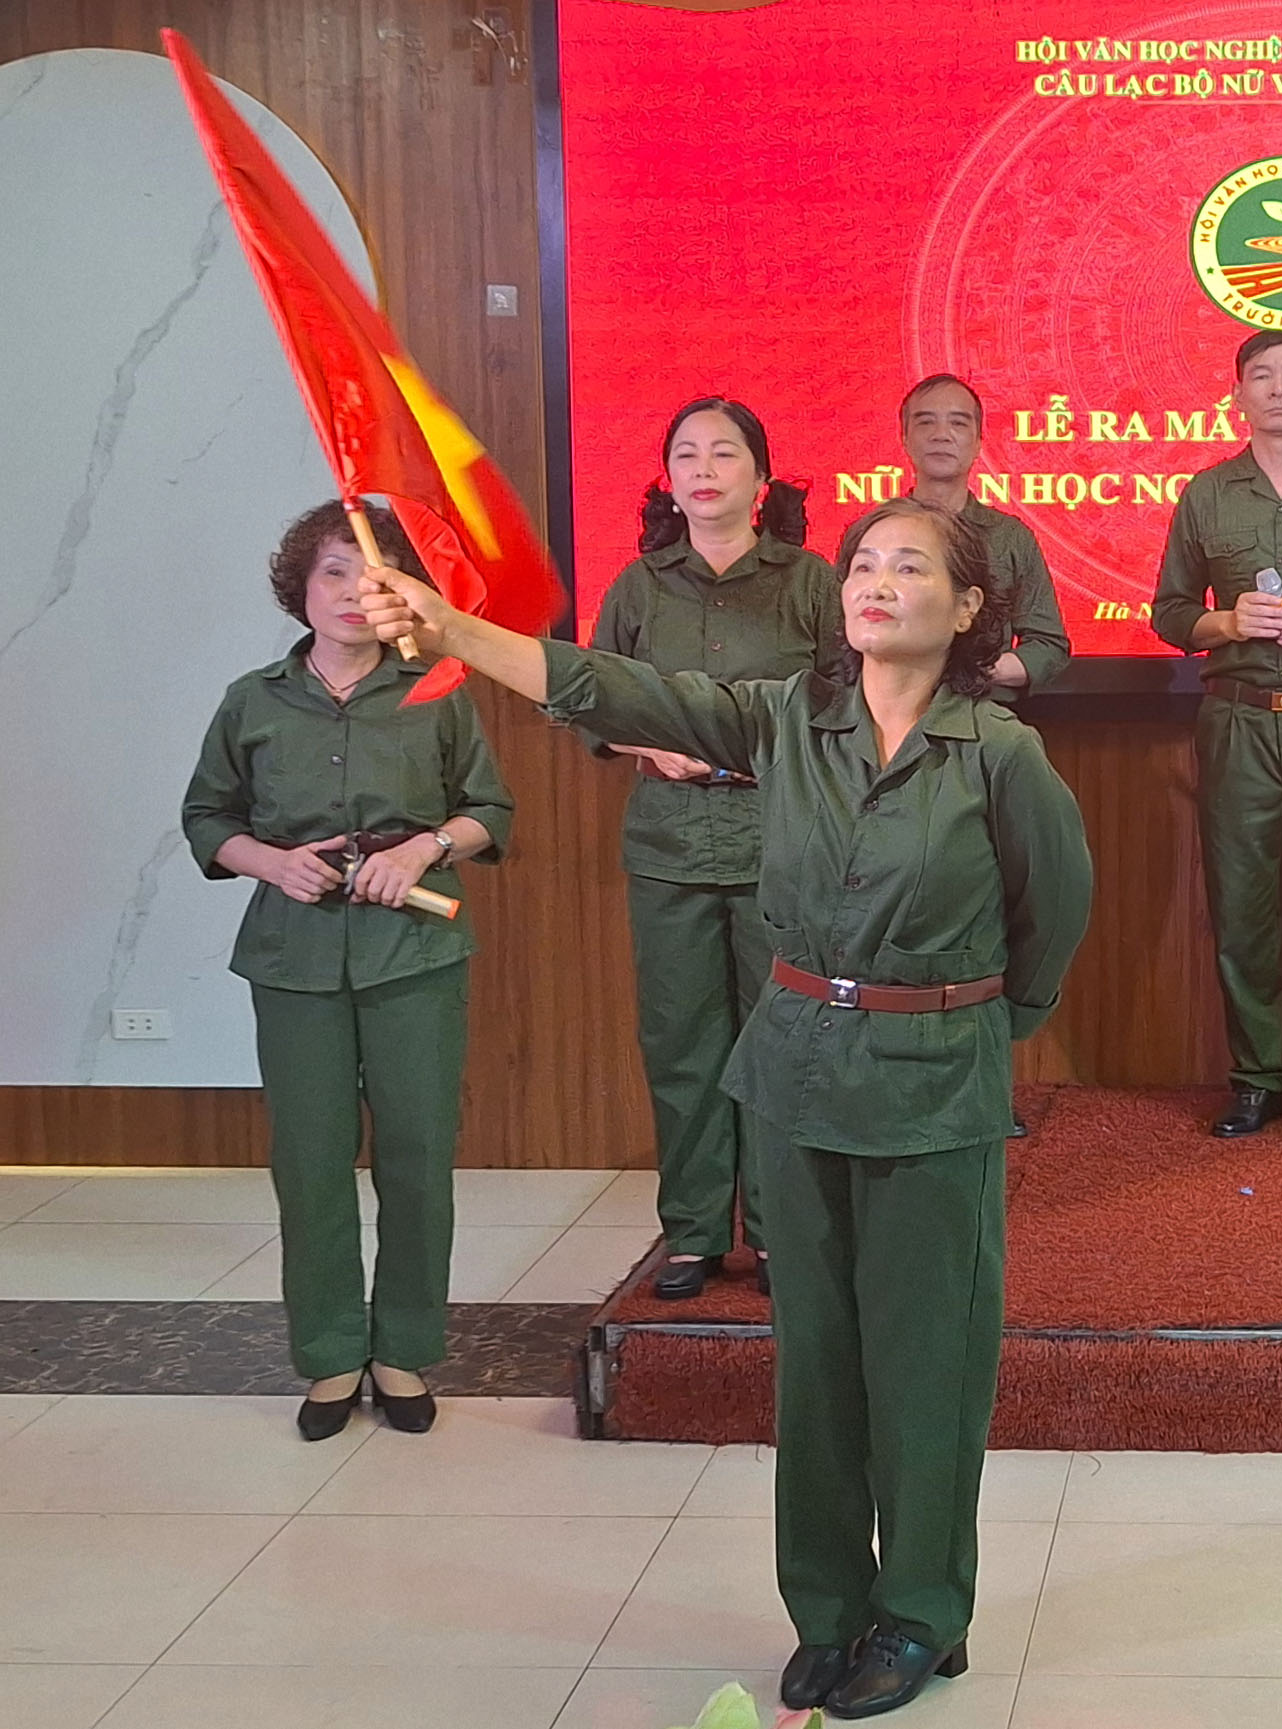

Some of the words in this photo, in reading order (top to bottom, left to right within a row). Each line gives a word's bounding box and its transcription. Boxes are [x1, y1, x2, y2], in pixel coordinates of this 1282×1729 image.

[1016, 36, 1068, 64] HỘI
[1074, 37, 1132, 61] VĂN
[1139, 40, 1198, 64] HỌC
[1205, 35, 1282, 63] NGHỆ
[1034, 68, 1097, 96] CÂU
[1104, 73, 1168, 99] LẠC
[1174, 68, 1215, 98] BỘ
[1222, 69, 1264, 95] NỮ
[1200, 211, 1217, 242] HỘI
[1014, 394, 1075, 442] LỄ
[1088, 410, 1153, 442] RA
[1164, 395, 1251, 442] MẮ
[835, 465, 904, 504] NỮ
[1020, 473, 1121, 511] HỌC
[1094, 602, 1130, 620] Hà
